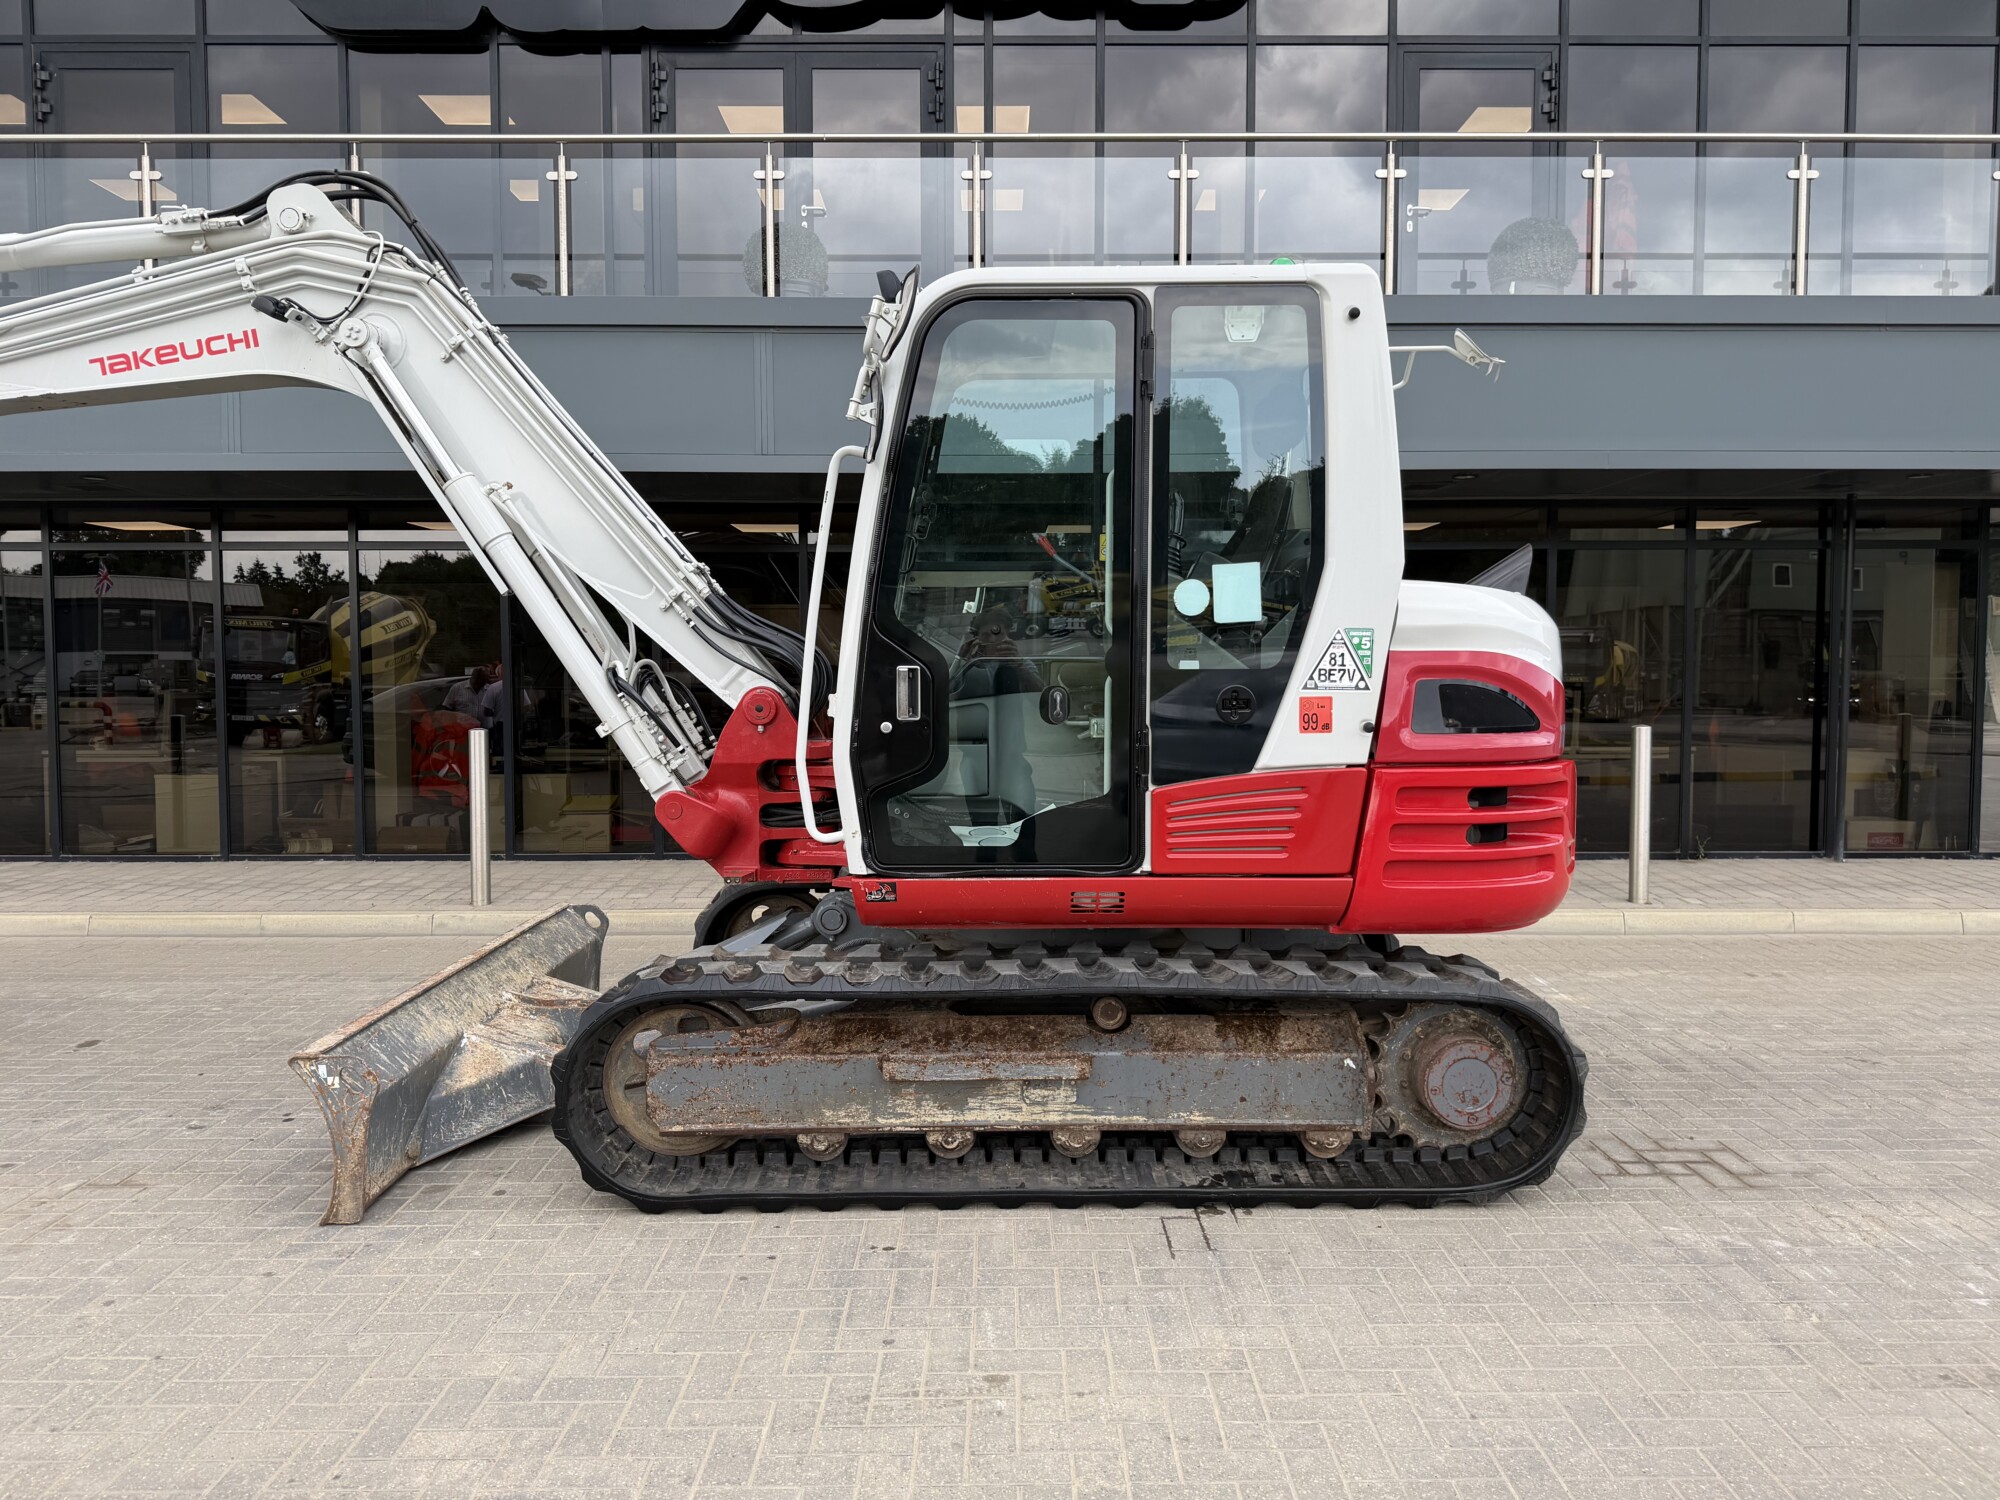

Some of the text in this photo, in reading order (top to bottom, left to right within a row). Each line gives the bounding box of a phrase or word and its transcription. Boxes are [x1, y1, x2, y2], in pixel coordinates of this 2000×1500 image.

[1361, 637, 1371, 649] 5
[1328, 652, 1347, 667] 81
[1318, 668, 1356, 682] BE7V
[1302, 712, 1330, 731] 99 dB
